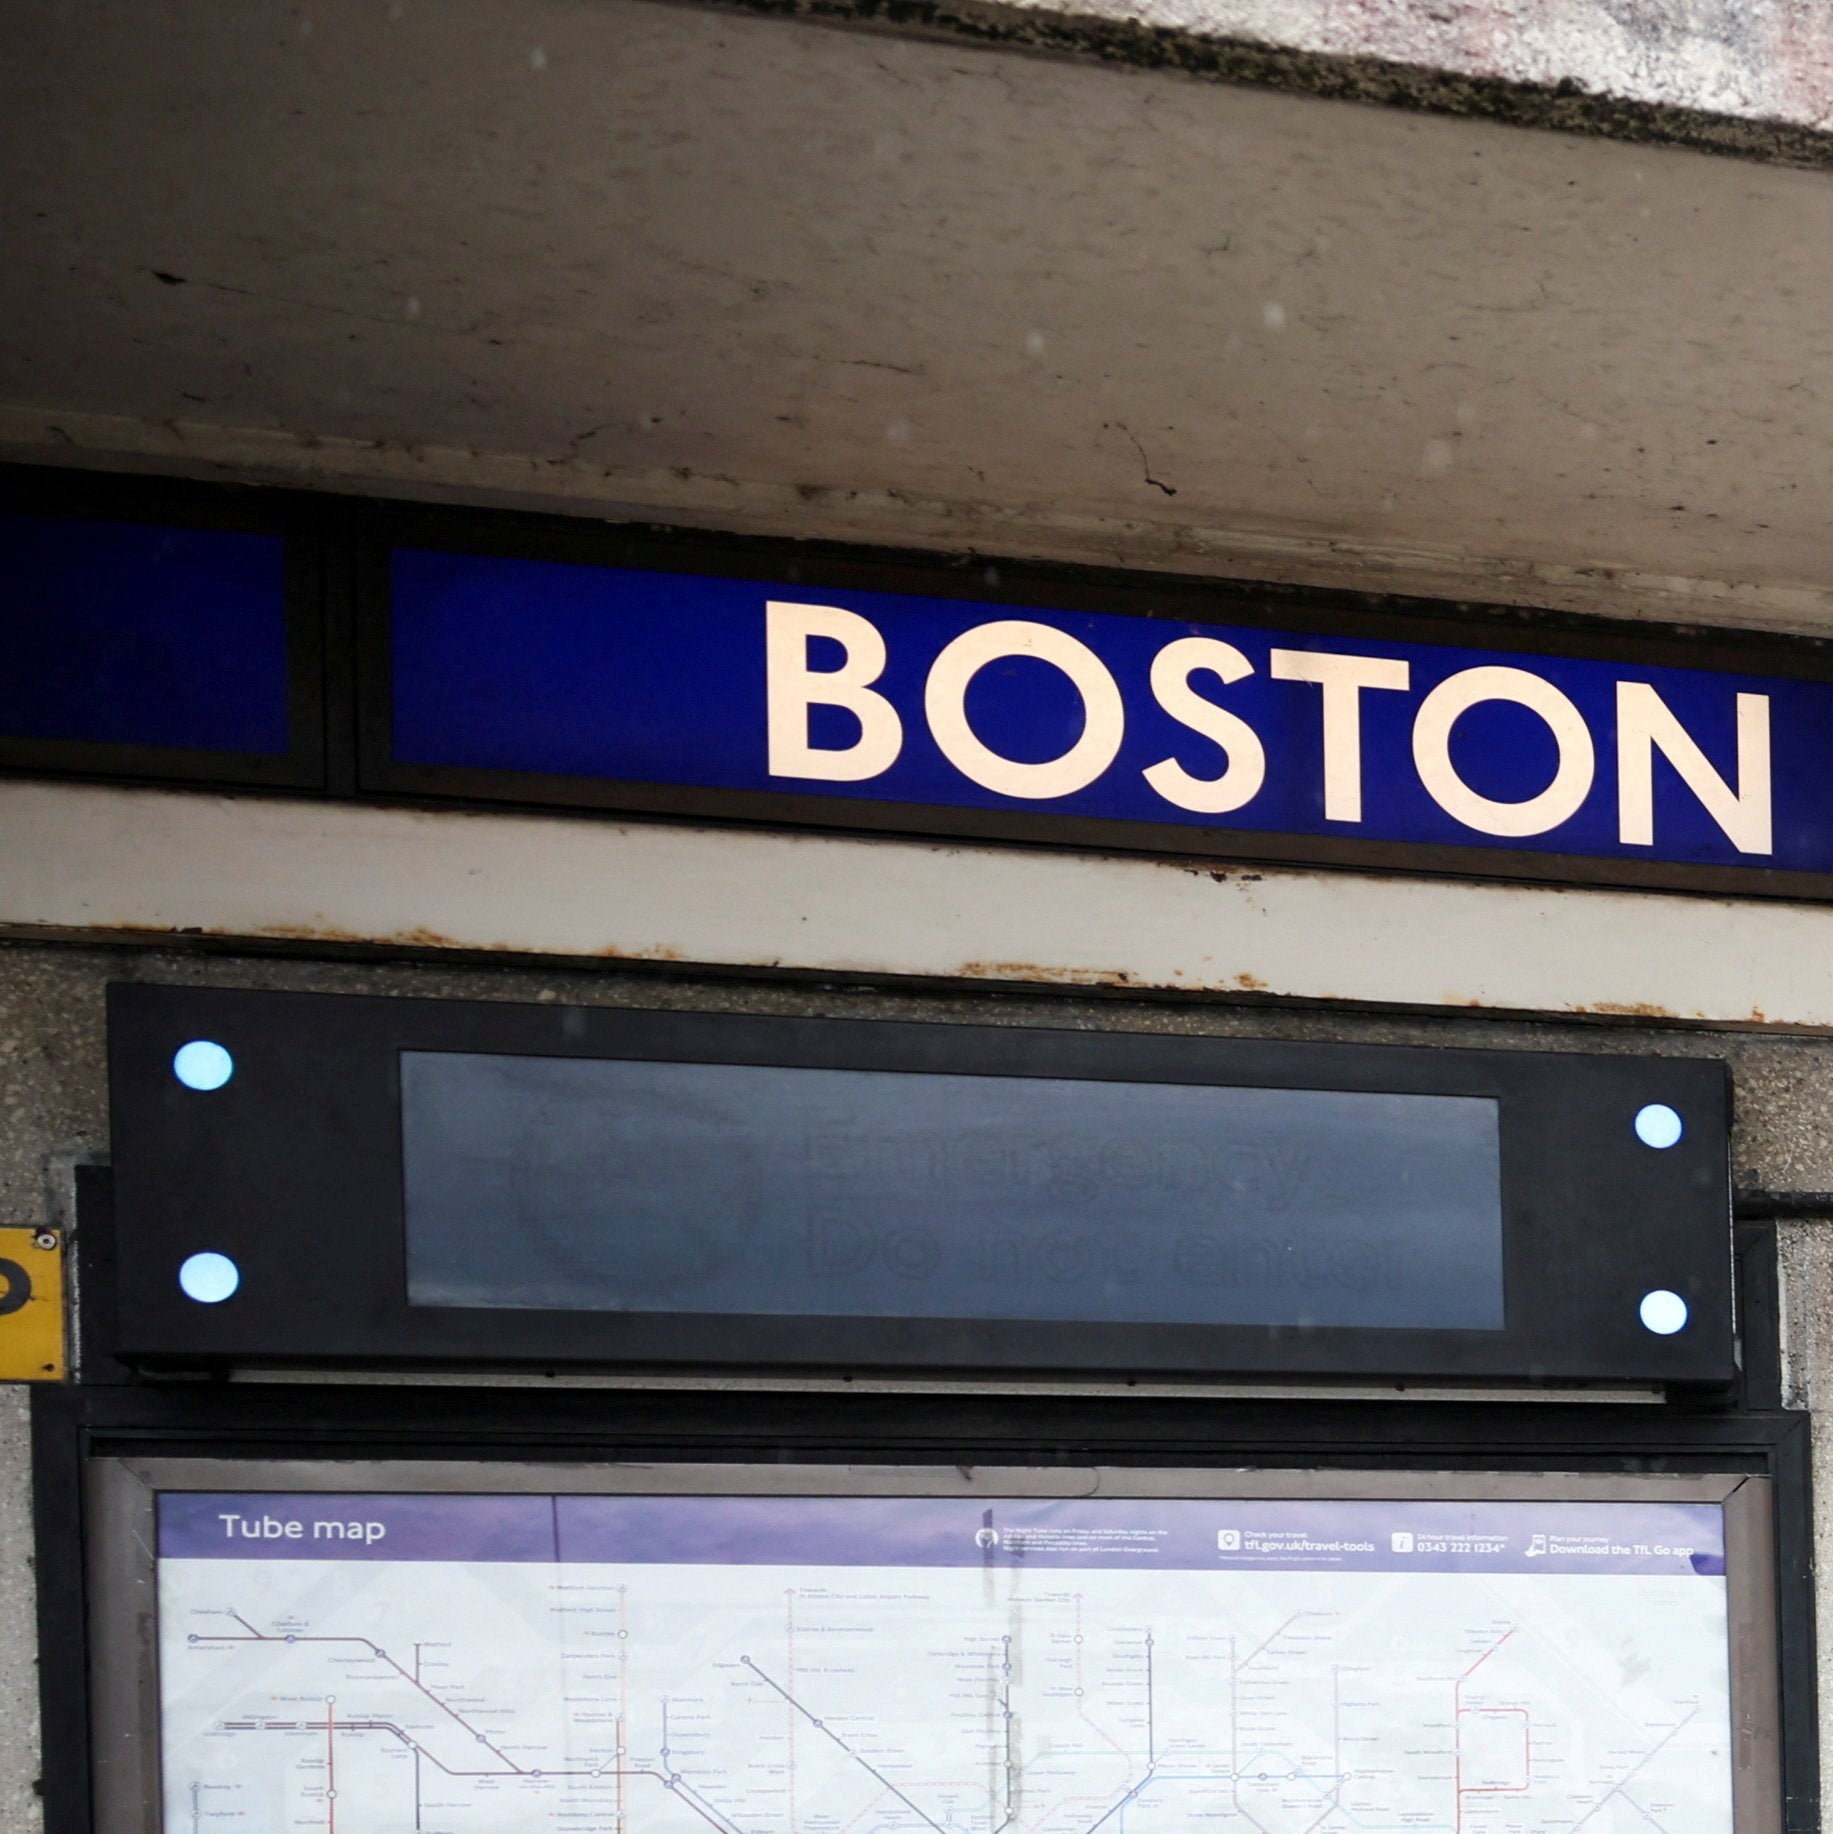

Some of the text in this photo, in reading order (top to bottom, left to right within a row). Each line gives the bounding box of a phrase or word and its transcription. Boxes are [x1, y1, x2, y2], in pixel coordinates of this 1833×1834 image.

[765, 600, 1772, 855] BOSTON
[804, 1131, 1310, 1212] Emergency
[219, 1514, 386, 1545] Tube map
[1244, 1539, 1375, 1554] tfl.gov.uk/travel-tools
[1417, 1543, 1447, 1553] 0343
[1450, 1543, 1471, 1553] 222
[1550, 1544, 1695, 1558] Download the TfL Go app
